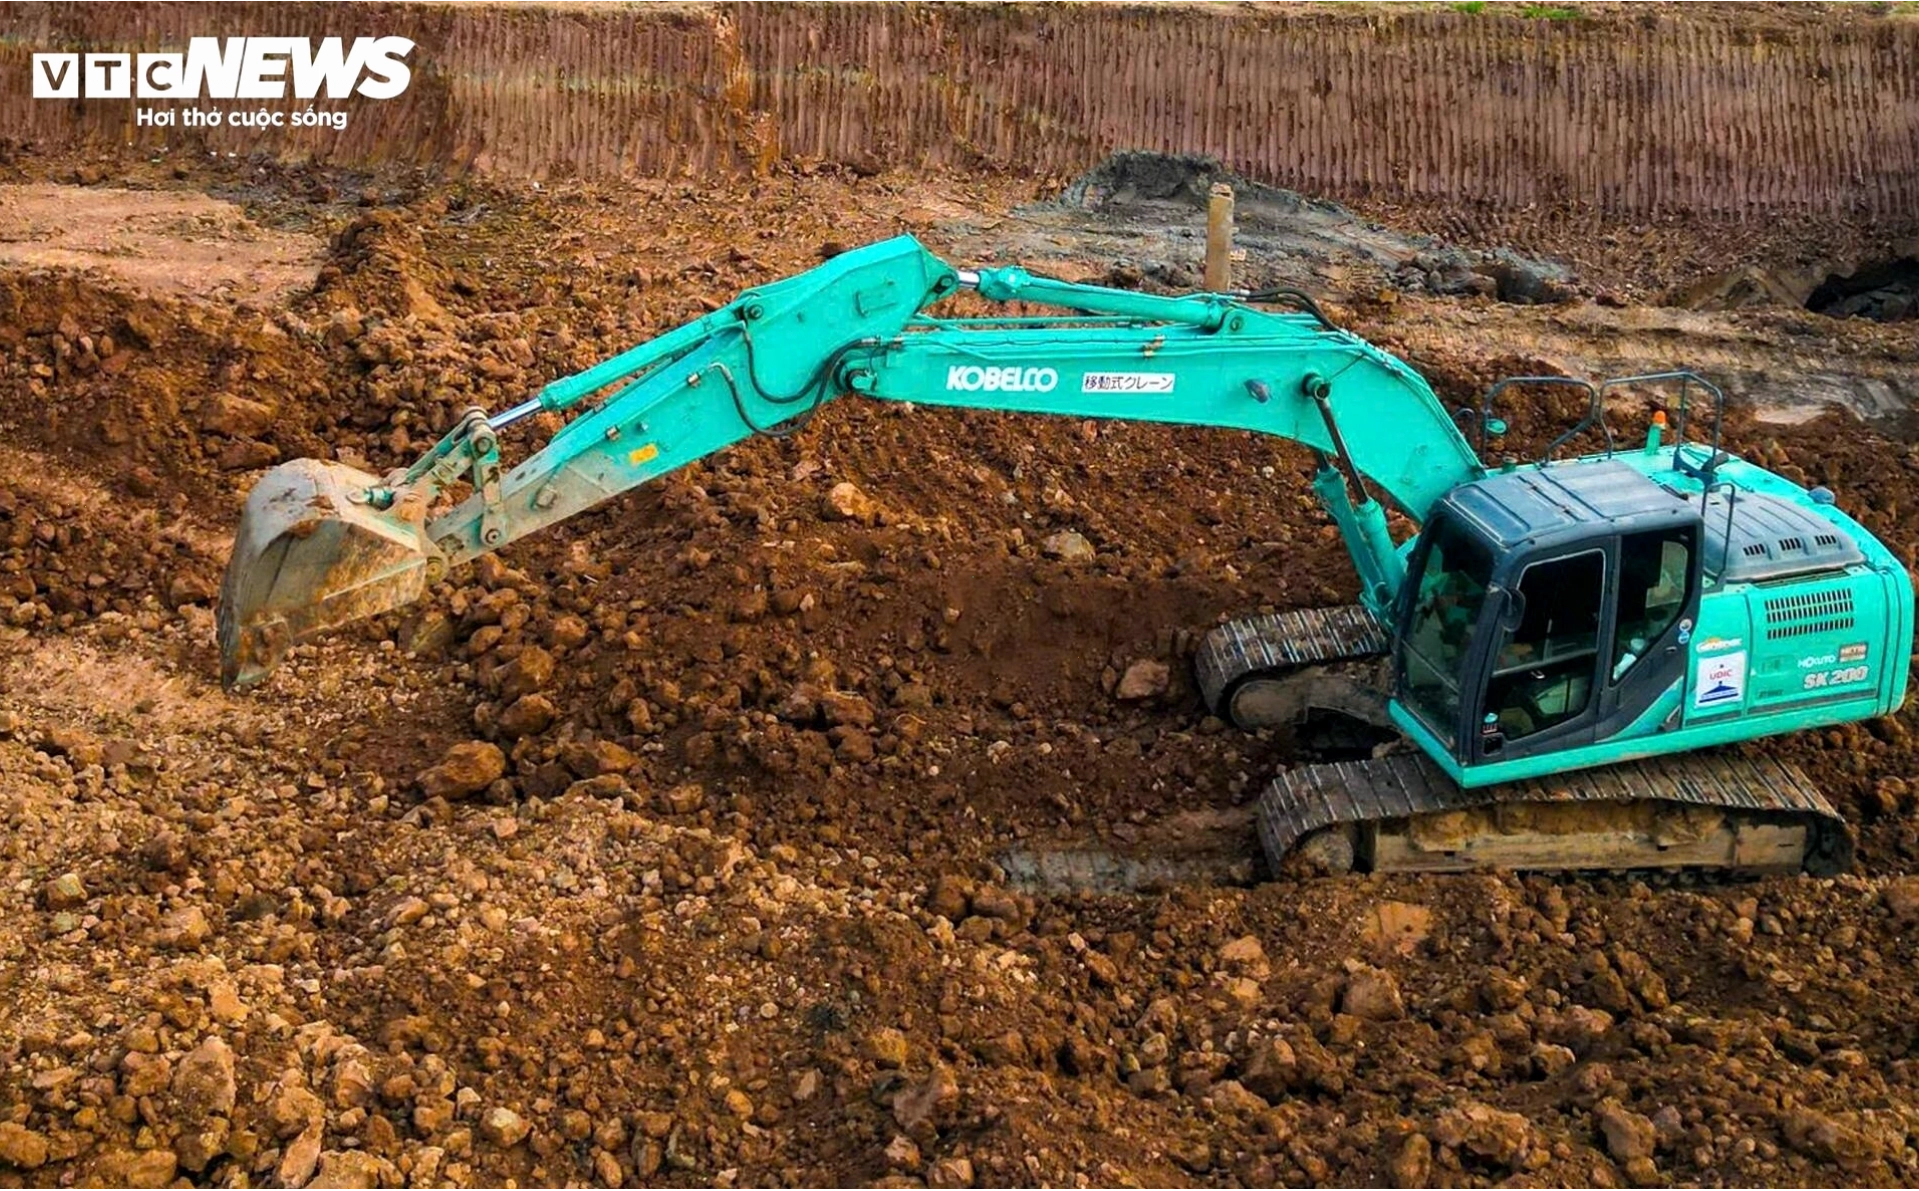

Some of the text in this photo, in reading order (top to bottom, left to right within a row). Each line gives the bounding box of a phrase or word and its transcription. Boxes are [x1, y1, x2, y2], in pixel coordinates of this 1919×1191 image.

[946, 366, 1058, 393] KOBELCO
[1084, 375, 1173, 391] 移動式クレーン
[1709, 669, 1733, 680] UDIC
